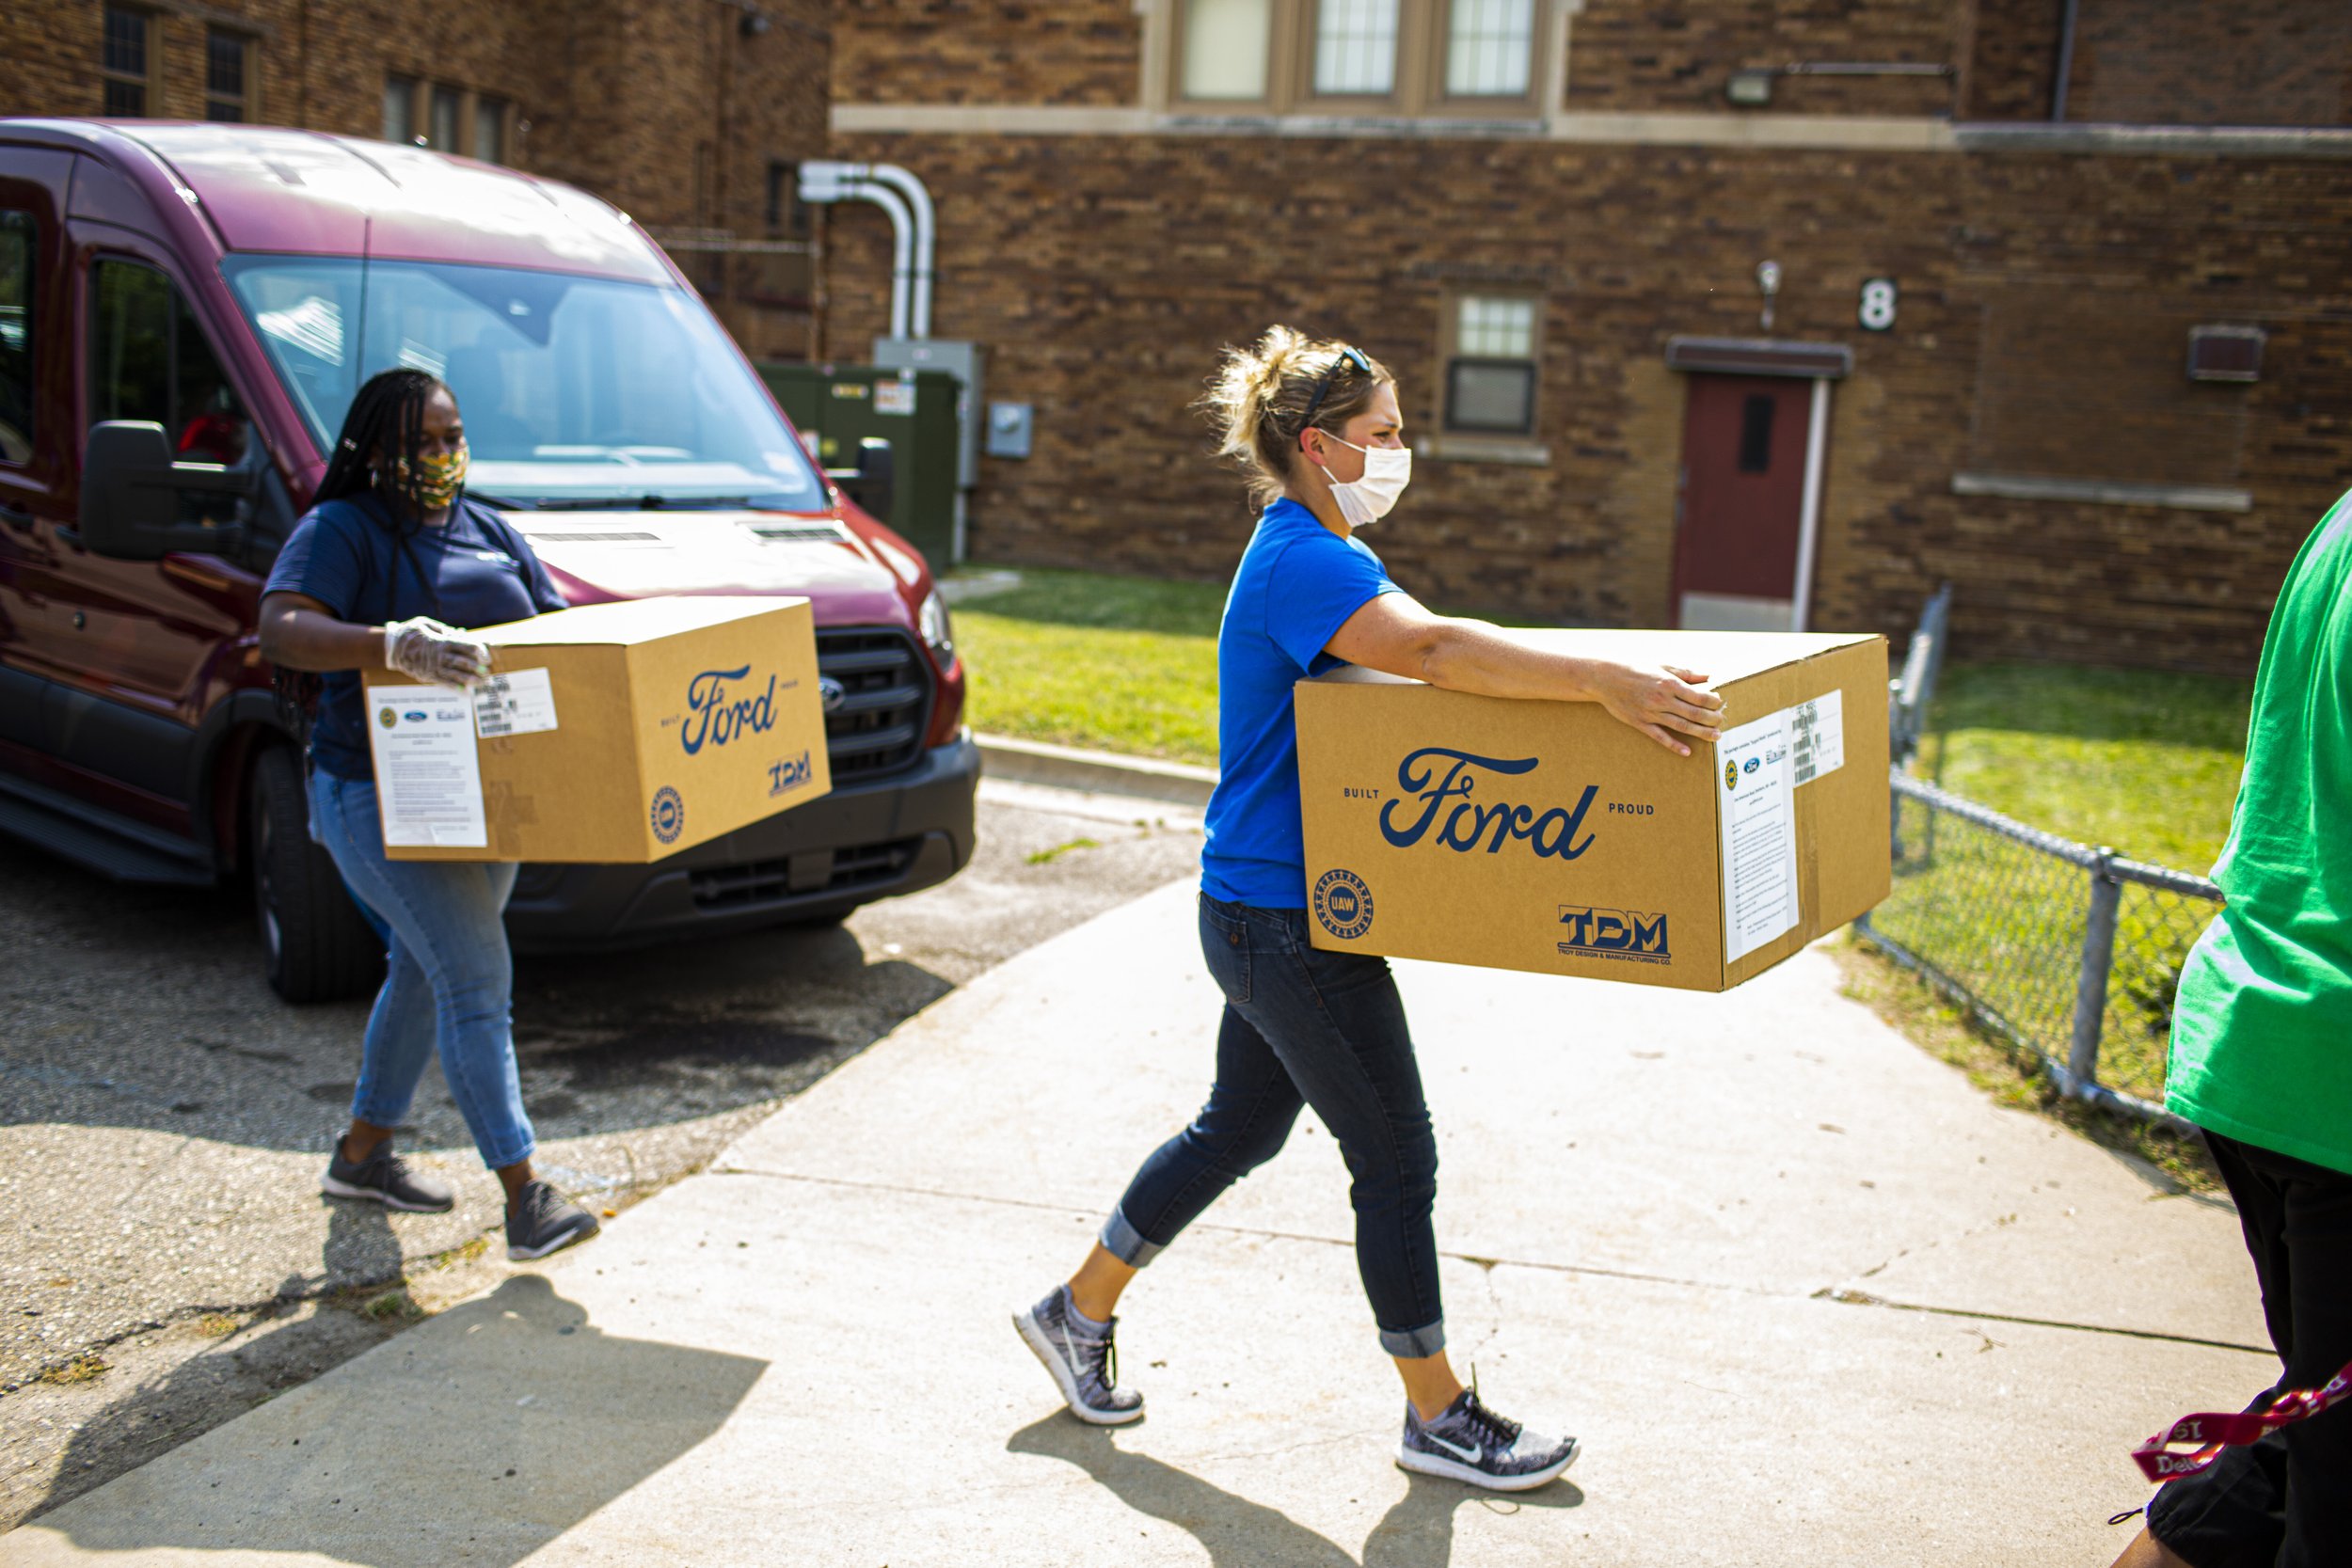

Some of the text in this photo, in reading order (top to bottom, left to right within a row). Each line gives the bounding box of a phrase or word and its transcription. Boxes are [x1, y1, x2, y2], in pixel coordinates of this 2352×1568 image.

[1858, 278, 1897, 330] 8
[681, 663, 778, 756] Ford
[767, 750, 812, 791] TDM
[1343, 747, 1655, 861] BUILT Ford PROUD
[1330, 895, 1355, 912] UAW
[1558, 904, 1668, 954] TDM
[1575, 950, 1598, 958] DESIGN
[1605, 953, 1660, 965] MANUFACTURING
